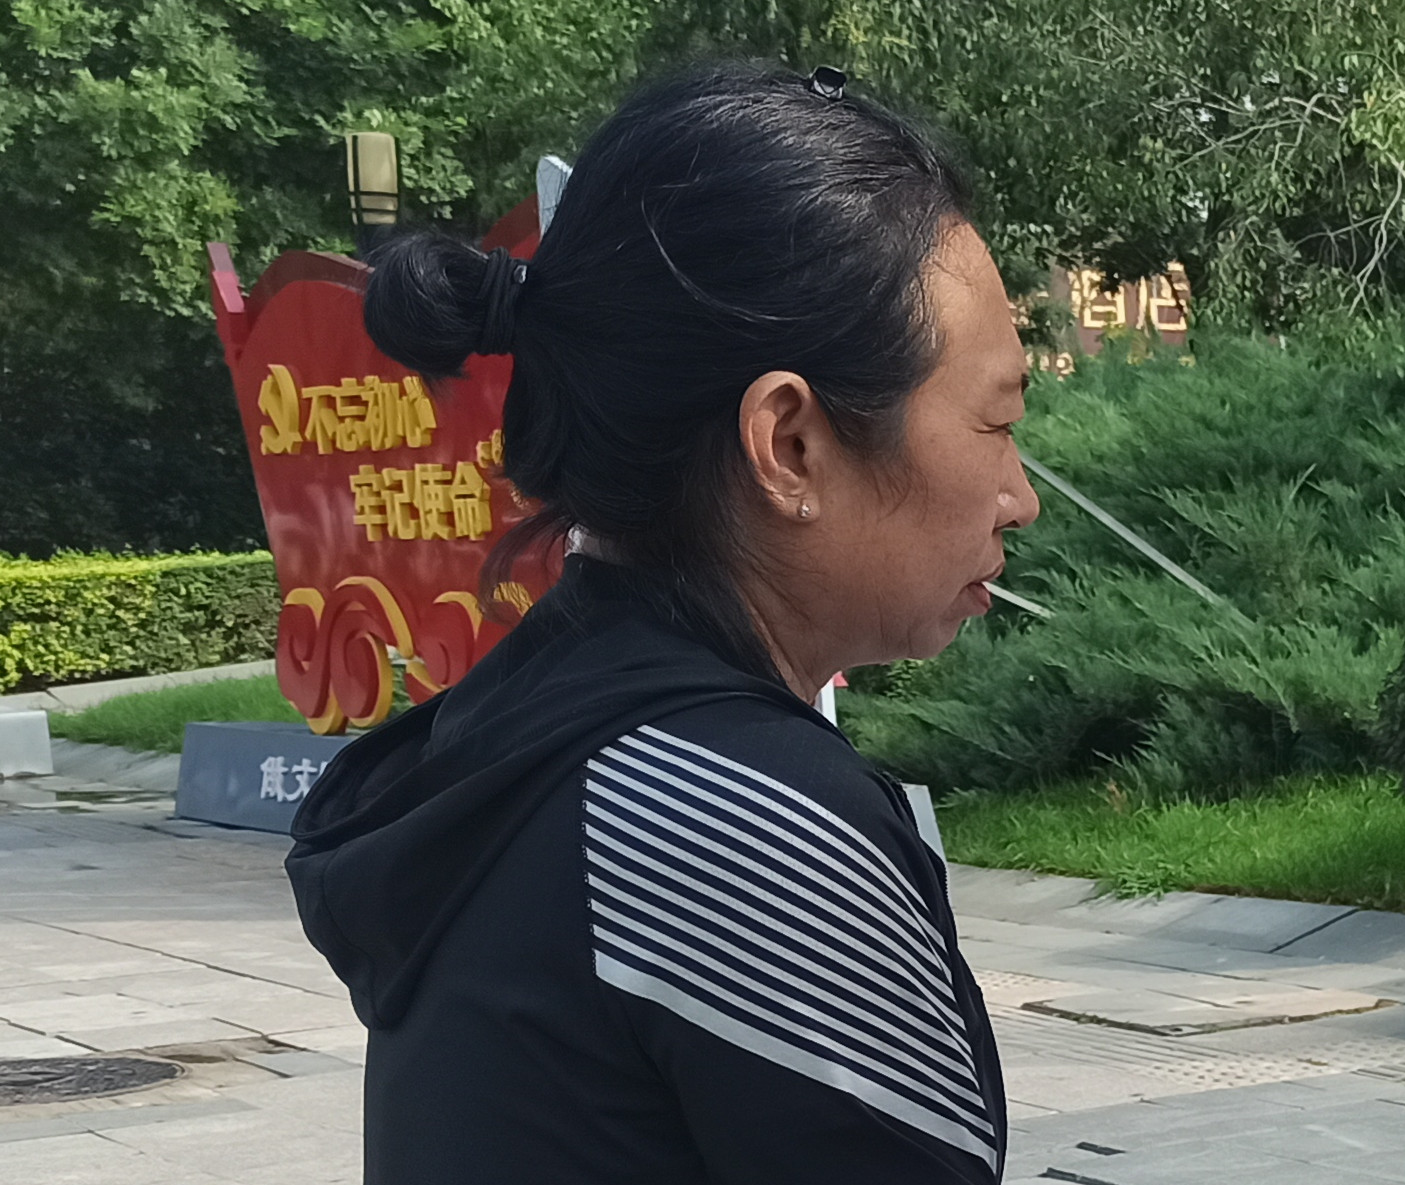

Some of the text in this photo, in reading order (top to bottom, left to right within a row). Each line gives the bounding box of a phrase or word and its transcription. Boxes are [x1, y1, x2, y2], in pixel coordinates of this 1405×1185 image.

[301, 374, 437, 455] 不忘初心
[349, 461, 493, 541] 牢记使命
